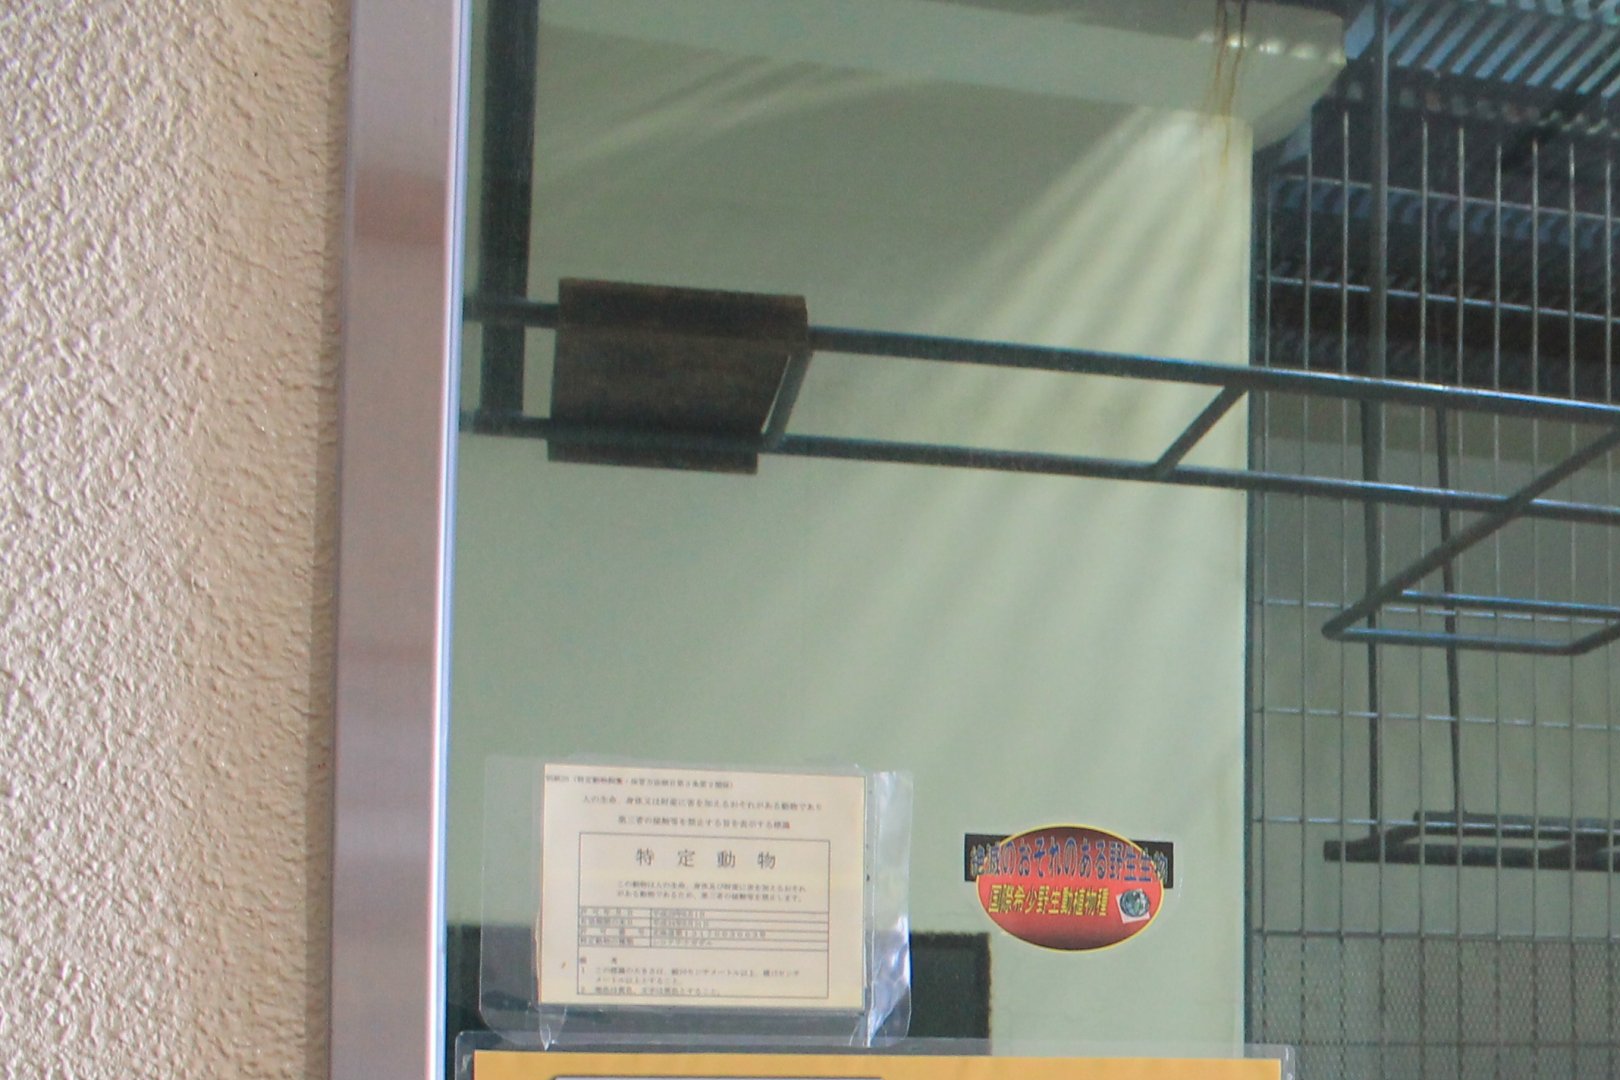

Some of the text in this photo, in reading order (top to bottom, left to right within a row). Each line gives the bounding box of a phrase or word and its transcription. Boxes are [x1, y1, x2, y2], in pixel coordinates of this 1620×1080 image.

[636, 848, 776, 869] 特定動物
[989, 884, 1109, 915] 国際希少野生動植物種
